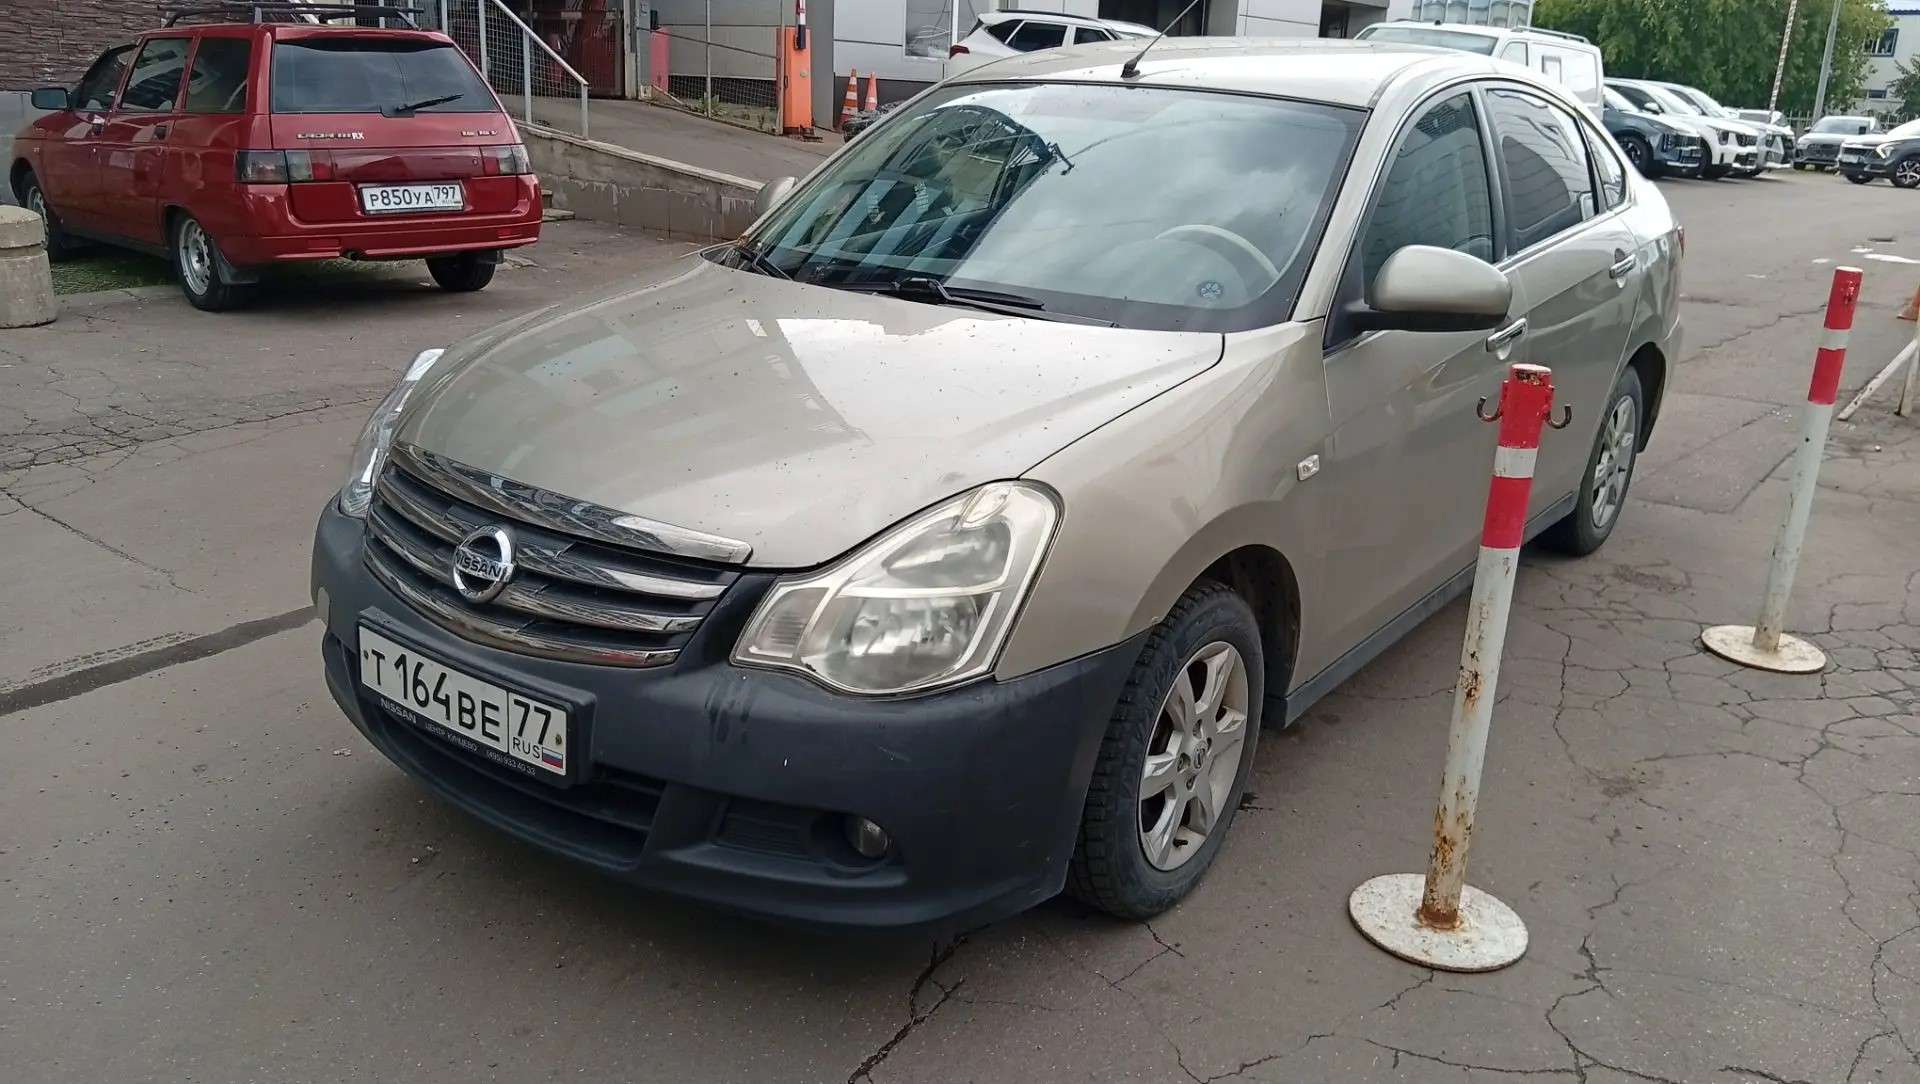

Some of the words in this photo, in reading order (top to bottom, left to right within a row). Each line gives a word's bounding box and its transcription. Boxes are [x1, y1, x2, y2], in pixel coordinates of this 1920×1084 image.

[369, 188, 434, 207] Р850УА
[434, 186, 456, 200] 797
[380, 698, 417, 724] NISSAN
[513, 699, 551, 746] 77
[512, 736, 541, 759] RUS
